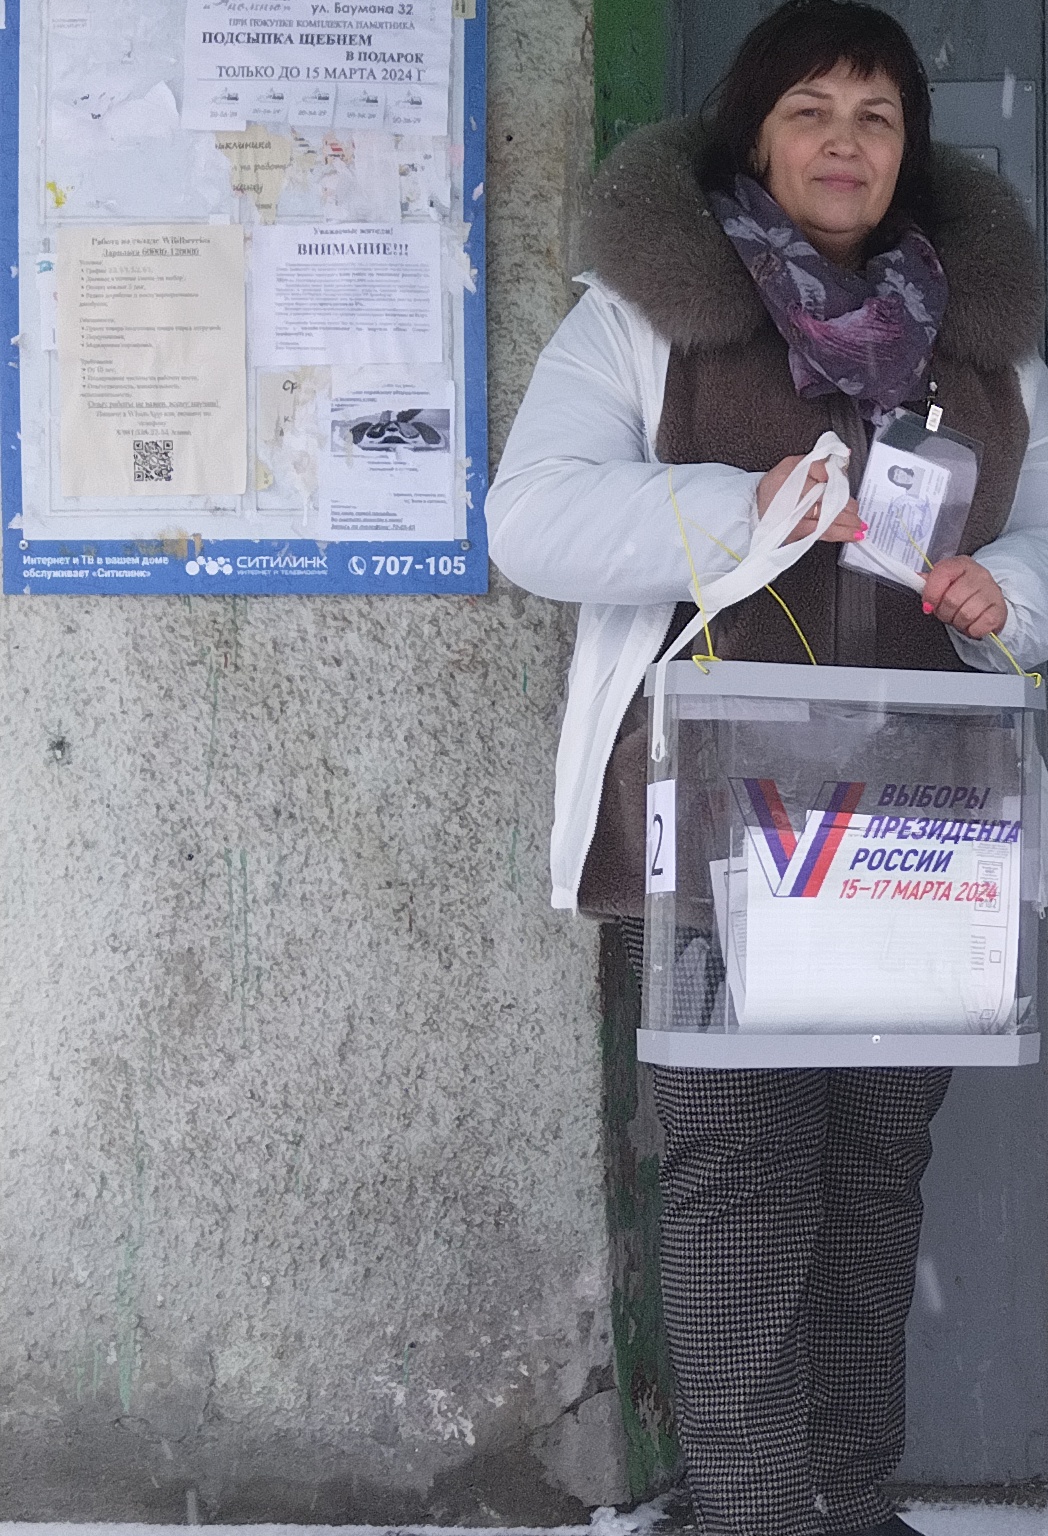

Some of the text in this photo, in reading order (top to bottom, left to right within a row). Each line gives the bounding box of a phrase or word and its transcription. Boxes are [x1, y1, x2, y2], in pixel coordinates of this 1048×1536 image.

[311, 4, 329, 15] ул.
[334, 2, 394, 15] Баумана
[296, 19, 353, 29] КОМПЛЕКТА
[356, 20, 416, 31] ПАМЯТНИКА
[202, 31, 373, 47] ПОДСЫПКА ЩЕБНЕМ
[346, 50, 424, 64] В ПОДАРОК
[216, 65, 275, 79] ТОЛЬКО
[278, 65, 301, 81] ДО
[306, 66, 320, 80] 15
[324, 67, 376, 81] МАРТА
[381, 68, 413, 82] 2024
[297, 242, 409, 256] ВНИМАНИЕ!!!
[22, 555, 169, 568] Интернет и ТВ в вашем доме
[236, 555, 328, 569] СИТИЛИНК
[371, 555, 466, 576] 707-105
[23, 567, 152, 580] обслуживает «Ситилинк»
[877, 783, 991, 810] ВЫБОРЫ
[863, 814, 1022, 845] ПРЕЗИДЕНТА
[651, 813, 664, 877] 2
[849, 847, 954, 873] РОССИИ
[891, 880, 953, 901] МАРТА
[954, 881, 998, 902] 2024
